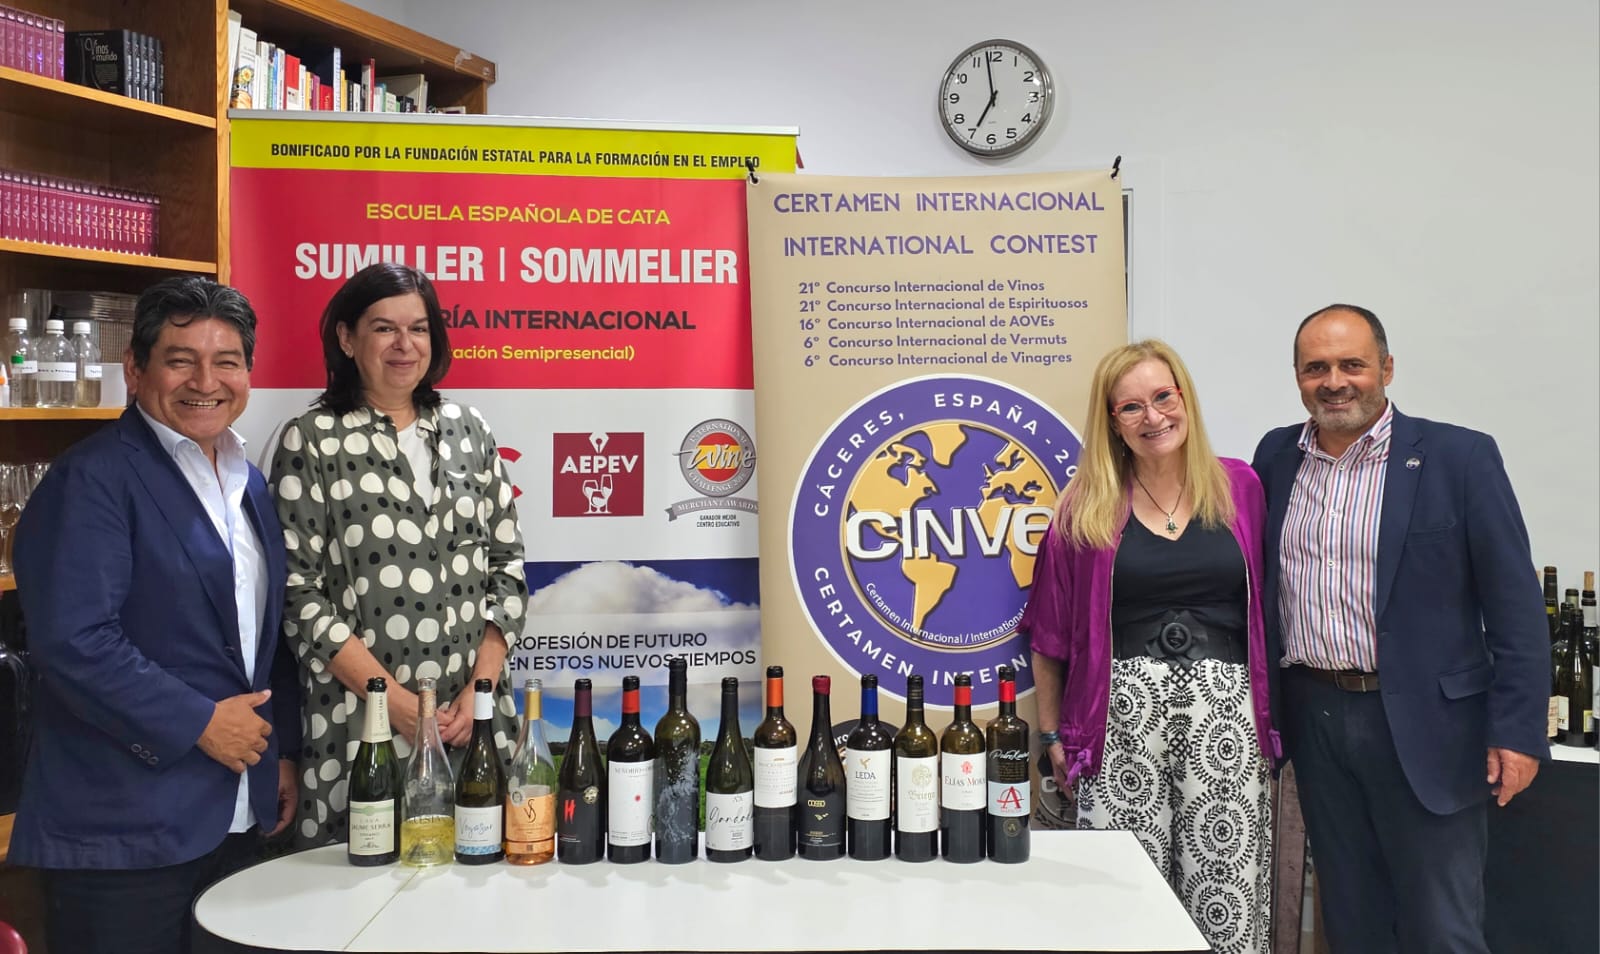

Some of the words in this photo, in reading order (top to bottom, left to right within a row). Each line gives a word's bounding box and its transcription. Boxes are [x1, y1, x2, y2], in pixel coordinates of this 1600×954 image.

[989, 51, 1003, 63] 12
[1023, 71, 1034, 82] 2
[949, 93, 960, 104] 9
[1028, 92, 1040, 103] 3
[953, 113, 965, 125] 8
[1021, 112, 1032, 124] 4
[967, 128, 977, 139] 7
[986, 133, 997, 145] 6
[1006, 128, 1017, 139] 5
[271, 143, 350, 158] BONIFICADO
[355, 146, 381, 159] POR
[385, 147, 401, 159] LA
[405, 146, 478, 161] FUNDACIÓN
[483, 150, 535, 163] ESTATAL
[539, 151, 573, 164] PARA
[576, 152, 592, 164] LA
[596, 151, 670, 167] FORMACIÓN
[674, 155, 689, 167] EN
[693, 156, 707, 167] EL
[711, 156, 760, 168] EMPLEO
[774, 193, 901, 213] CERTAMEN
[916, 191, 1105, 212] INTERNACIONAL
[366, 203, 464, 221] ESCUELA
[468, 203, 582, 224] ESPAÑOLA
[587, 209, 613, 224] DE
[617, 209, 671, 225] CATA
[784, 235, 974, 257] INTERNATIONAL
[990, 234, 1098, 255] CONTEST
[520, 247, 738, 284] SOMMELIER
[826, 281, 891, 294] Concurso
[894, 280, 984, 293] Internacional
[987, 279, 1004, 291] de
[1007, 279, 1045, 291] Vinos
[827, 300, 892, 312] Concurso
[895, 298, 985, 311] Internacional
[988, 297, 1005, 309] de
[1008, 297, 1088, 312] Espirituosos
[440, 304, 480, 329] RÍA
[485, 309, 697, 330] INTERNACIONAL
[828, 318, 892, 330] Concurso
[896, 316, 986, 329] Internacional
[989, 315, 1006, 327] de
[1009, 315, 1055, 327] AOVEs
[828, 336, 893, 348] Concurso
[897, 334, 987, 347] Internacional
[990, 333, 1007, 345] de
[1010, 333, 1067, 345] Vermuts
[452, 345, 498, 360] ación
[501, 345, 636, 363] Semipresencial)
[829, 354, 894, 366] Concurso
[898, 352, 988, 366] Internacional
[991, 352, 1008, 364] de
[1011, 351, 1072, 366] Vinagres
[672, 443, 757, 470] Wine
[814, 408, 905, 517] CÁCERES,
[934, 392, 1038, 436] ESPAÑA
[1054, 449, 1078, 478] 20
[560, 455, 639, 474] AEPEV
[866, 582, 901, 624] Certamen
[900, 619, 962, 644] Internacional
[970, 607, 1025, 642] International
[814, 567, 914, 677] CERTAMEN
[514, 632, 603, 650] ROFESIÓN
[607, 636, 630, 649] DE
[634, 632, 707, 649] FUTURO
[533, 655, 593, 670] ESTOS
[599, 653, 673, 669] NUEVOS
[855, 771, 876, 780] LEDA
